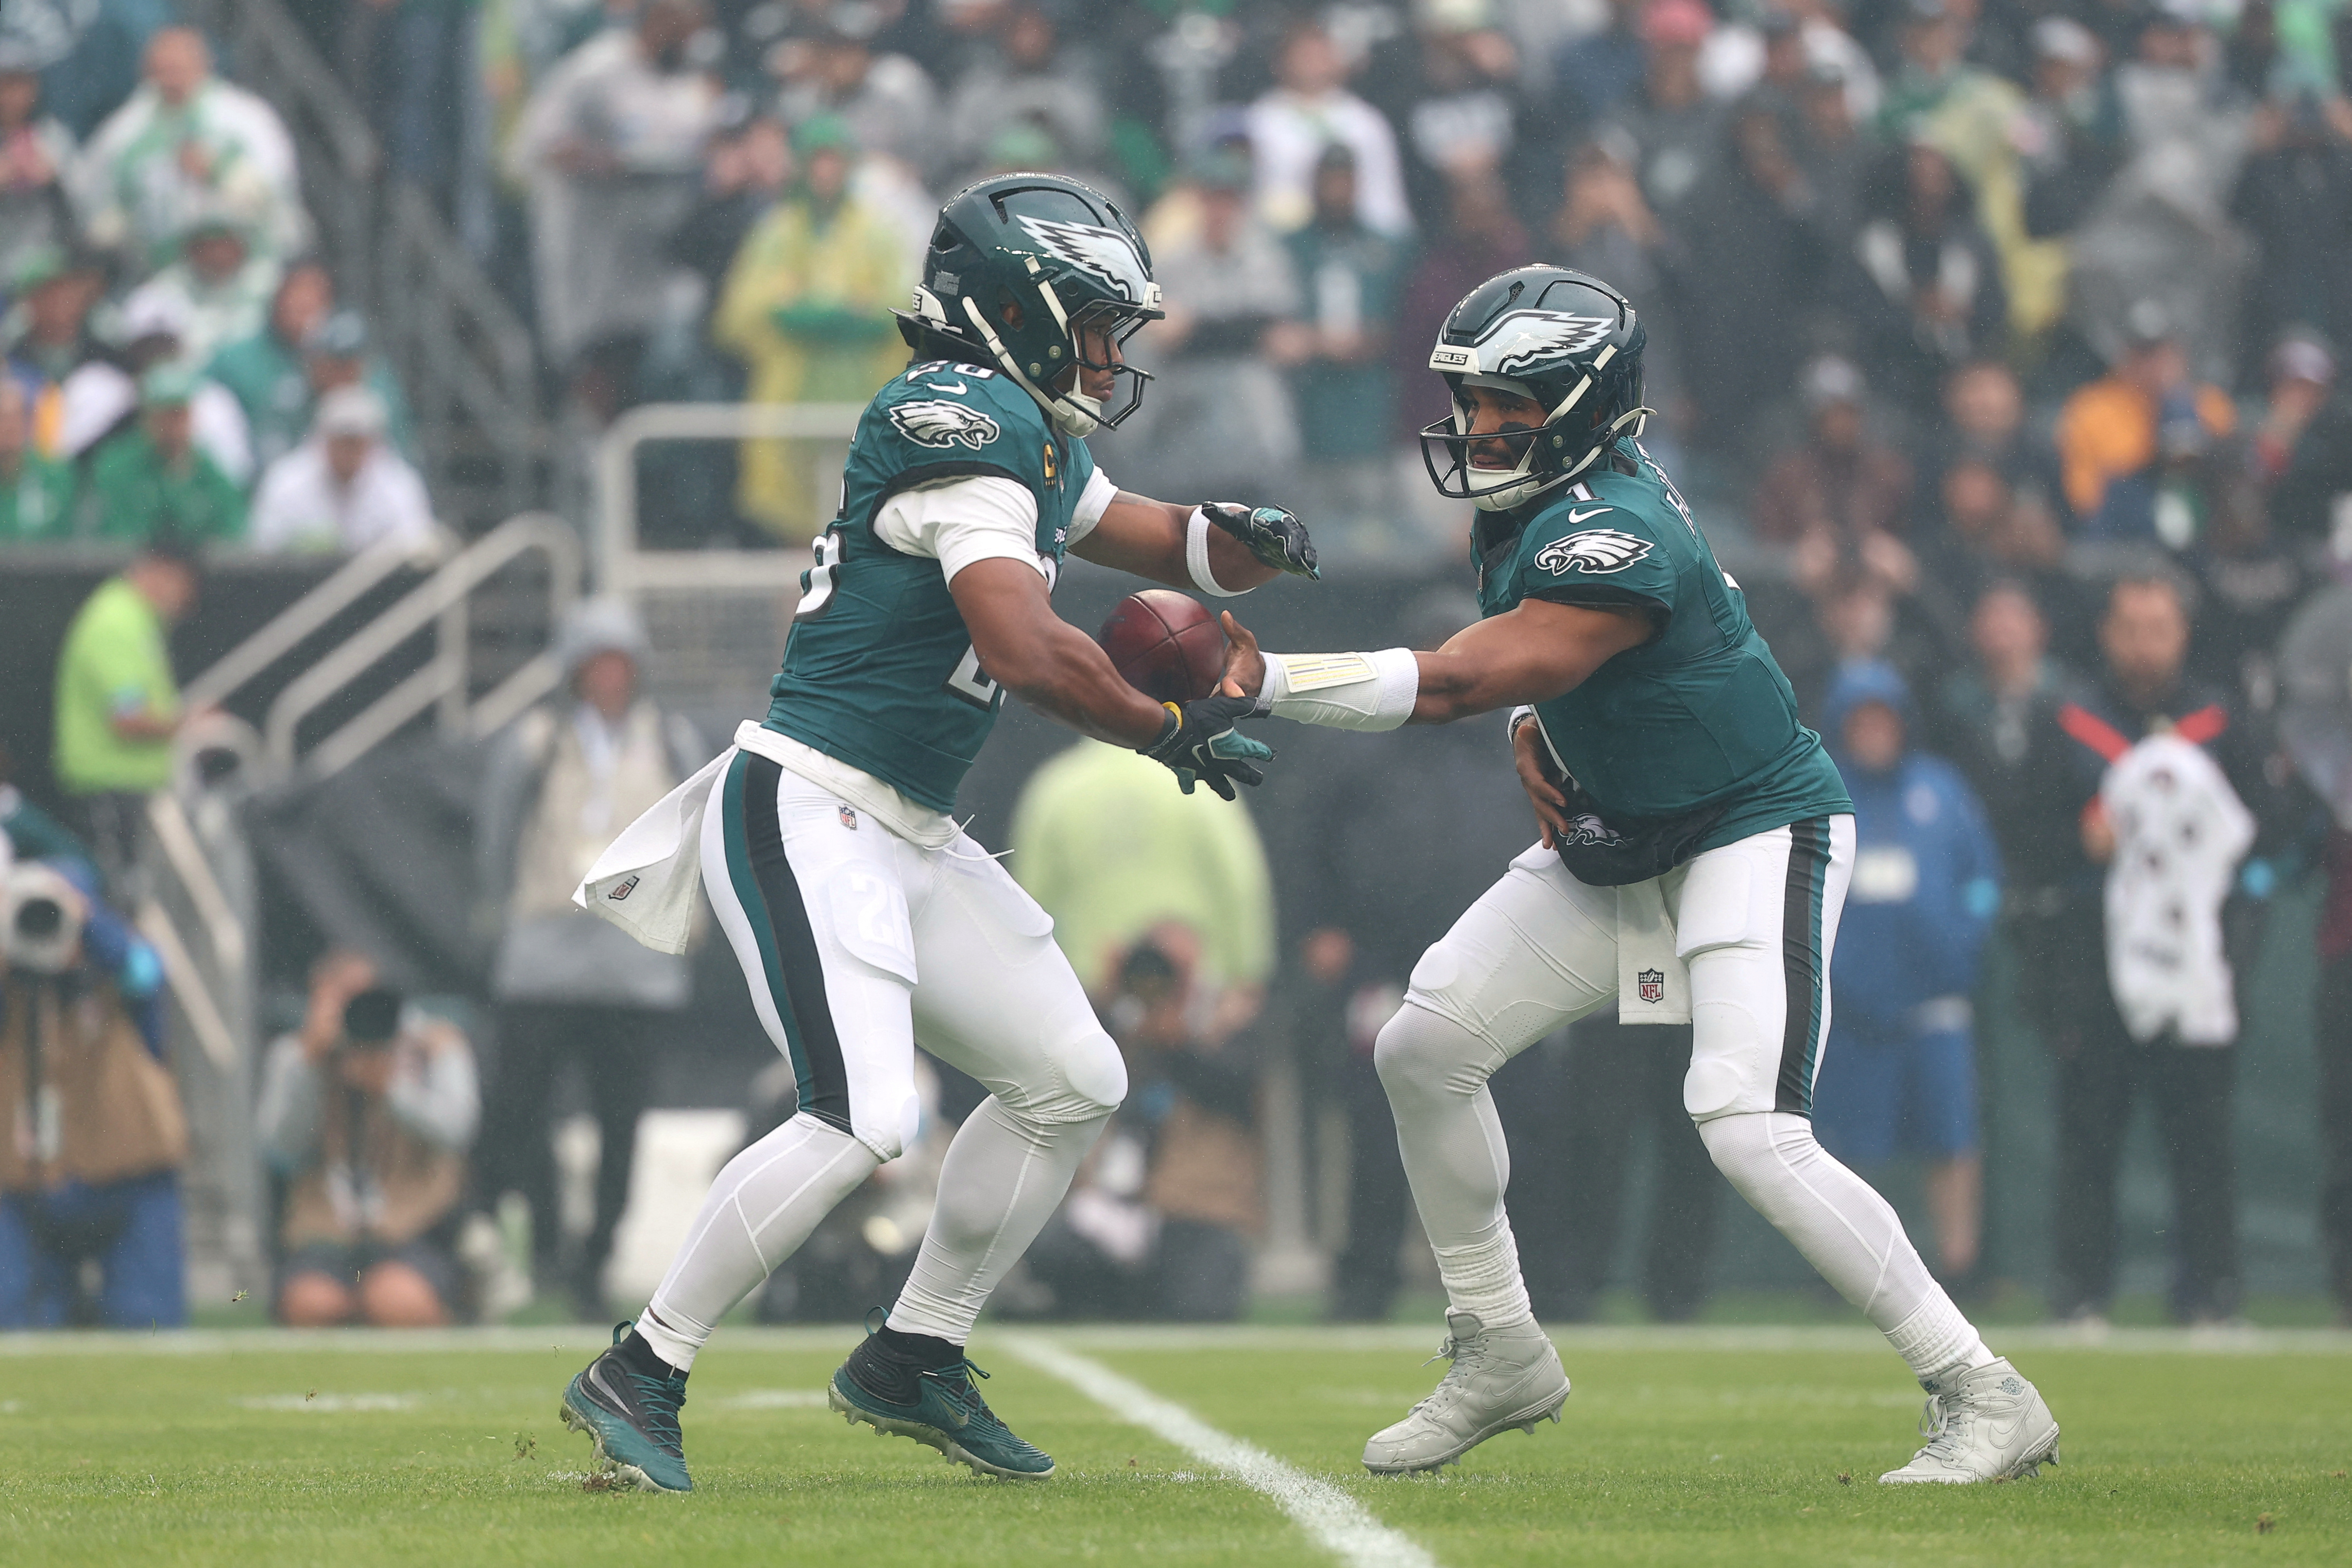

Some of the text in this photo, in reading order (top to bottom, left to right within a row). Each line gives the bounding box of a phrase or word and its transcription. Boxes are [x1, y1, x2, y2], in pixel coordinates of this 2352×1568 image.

[1434, 353, 1467, 364] EAGLES
[1566, 482, 1602, 502] 1
[1641, 984, 1661, 999] NFL
